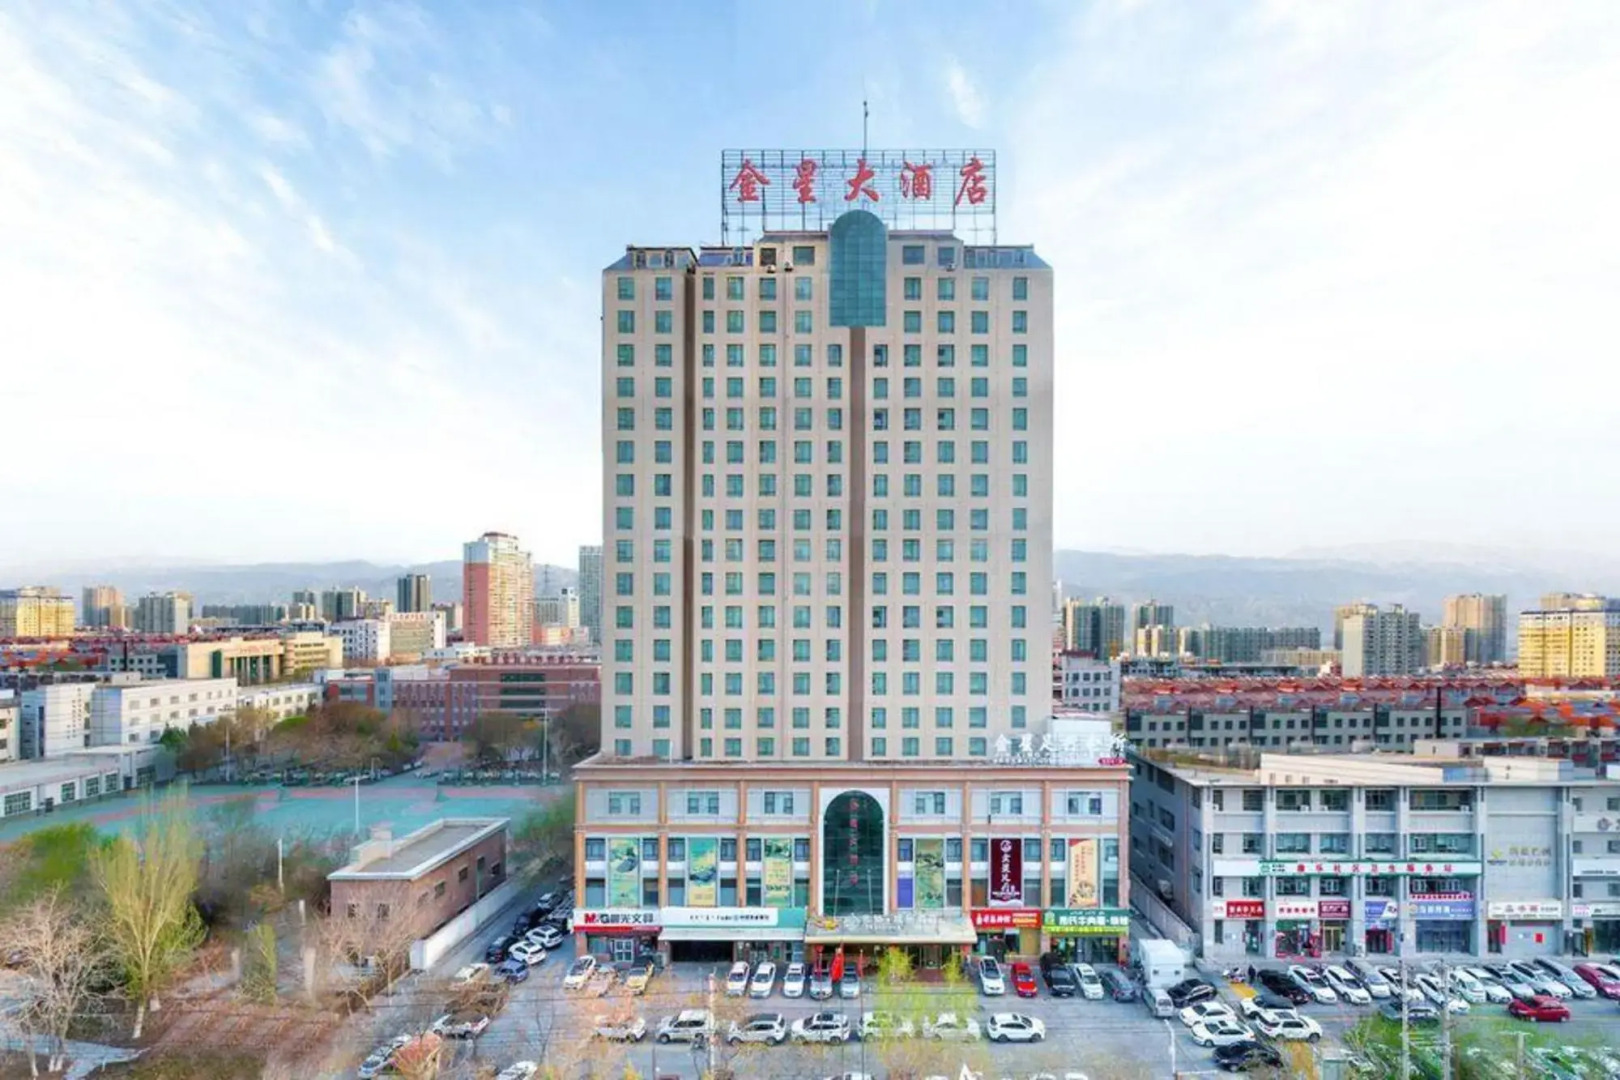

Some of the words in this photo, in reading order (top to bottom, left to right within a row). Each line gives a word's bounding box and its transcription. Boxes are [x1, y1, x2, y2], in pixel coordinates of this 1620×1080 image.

[729, 156, 988, 205] 金星大酒店
